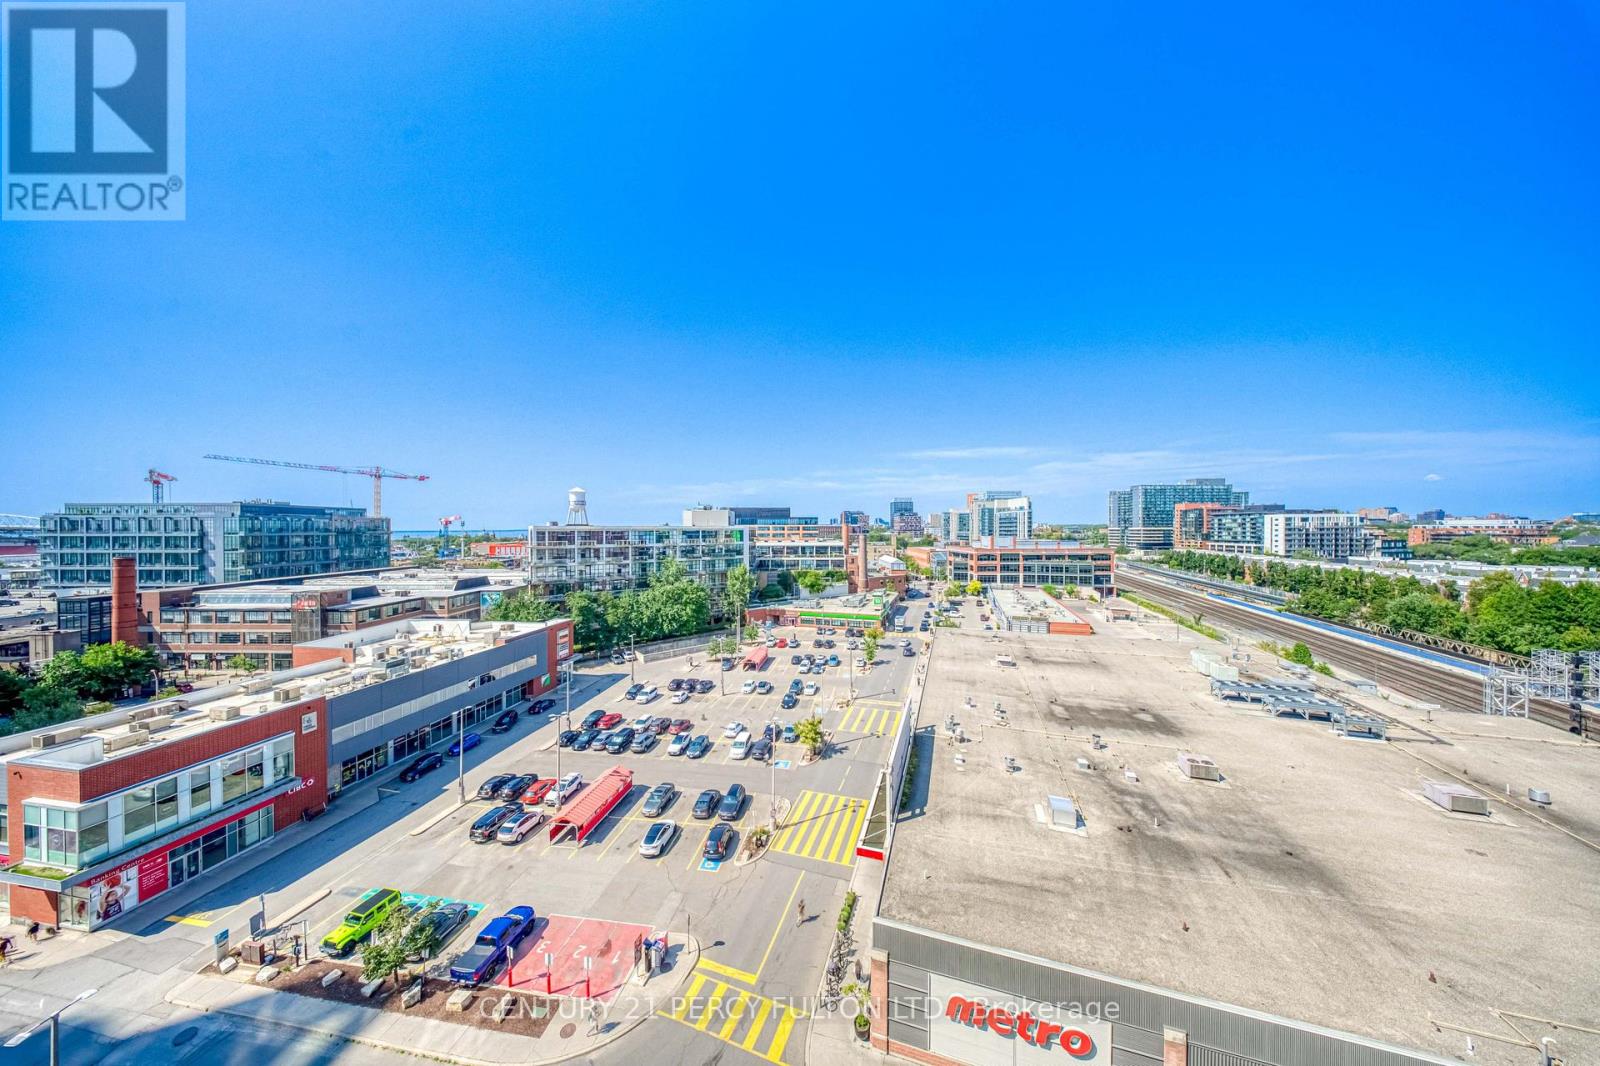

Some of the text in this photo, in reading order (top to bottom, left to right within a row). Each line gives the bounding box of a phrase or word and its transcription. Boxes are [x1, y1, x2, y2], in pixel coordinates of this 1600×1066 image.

[90, 868, 120, 885] Banking
[121, 858, 145, 871] Centre
[536, 940, 551, 953] 3
[572, 945, 587, 958] 2
[611, 950, 621, 964] 1
[945, 995, 1093, 1056] metro
